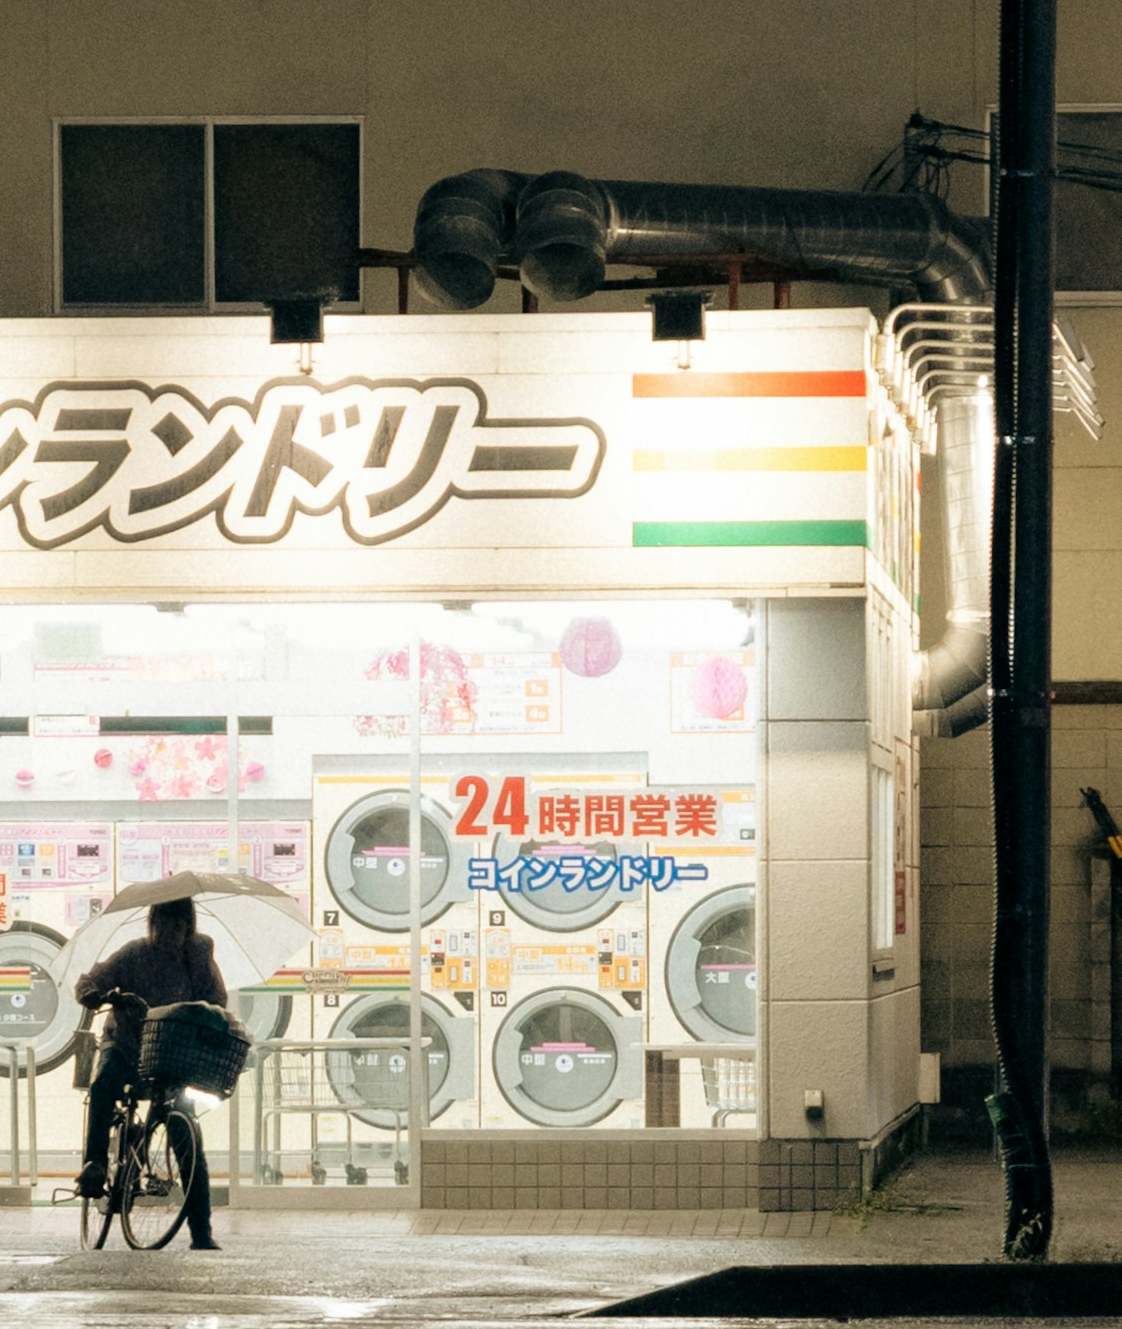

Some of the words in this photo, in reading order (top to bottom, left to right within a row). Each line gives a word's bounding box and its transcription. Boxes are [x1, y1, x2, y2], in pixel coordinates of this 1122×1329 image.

[469, 856, 709, 891] コインランドリー
[327, 912, 336, 924] 7
[492, 912, 502, 925] 9
[705, 971, 730, 985] 大型
[326, 994, 336, 1005] 8
[491, 994, 506, 1006] 10
